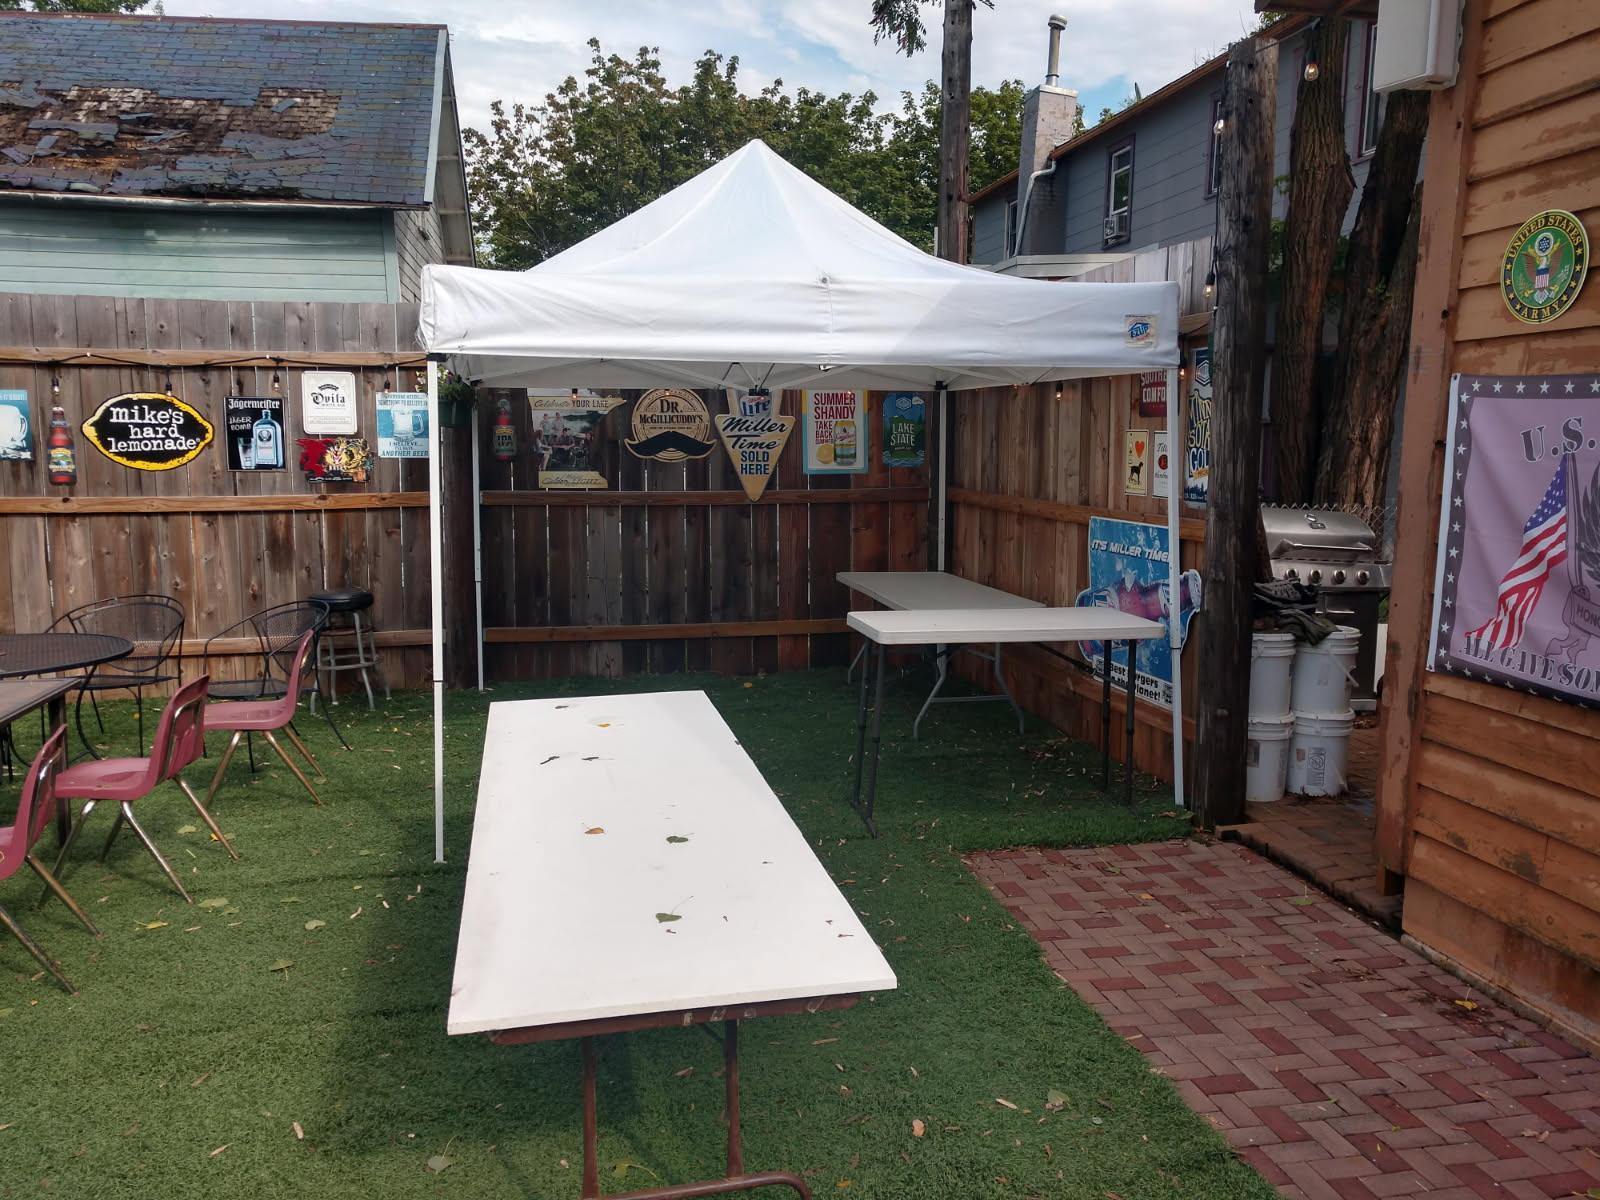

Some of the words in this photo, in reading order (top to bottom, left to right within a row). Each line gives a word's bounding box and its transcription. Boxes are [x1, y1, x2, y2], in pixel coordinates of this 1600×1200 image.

[1508, 219, 1545, 258] UNITED
[1547, 215, 1581, 245] STATES
[1521, 302, 1560, 318] ARMY
[311, 393, 345, 404] Ovila
[571, 400, 590, 408] YOUR
[592, 400, 609, 408] LAKE
[814, 393, 856, 405] SUMMER
[109, 405, 184, 424] mike's
[814, 406, 856, 419] SHANDY
[128, 424, 181, 439] hard
[722, 417, 787, 433] Miller
[815, 421, 833, 430] TAKE
[892, 423, 914, 433] LAKE
[726, 435, 778, 449] Time
[890, 433, 916, 446] STATE
[741, 451, 769, 462] SOLD
[741, 464, 769, 475] HERE
[1109, 543, 1142, 558] MILLER
[1136, 685, 1161, 701] lanet!
